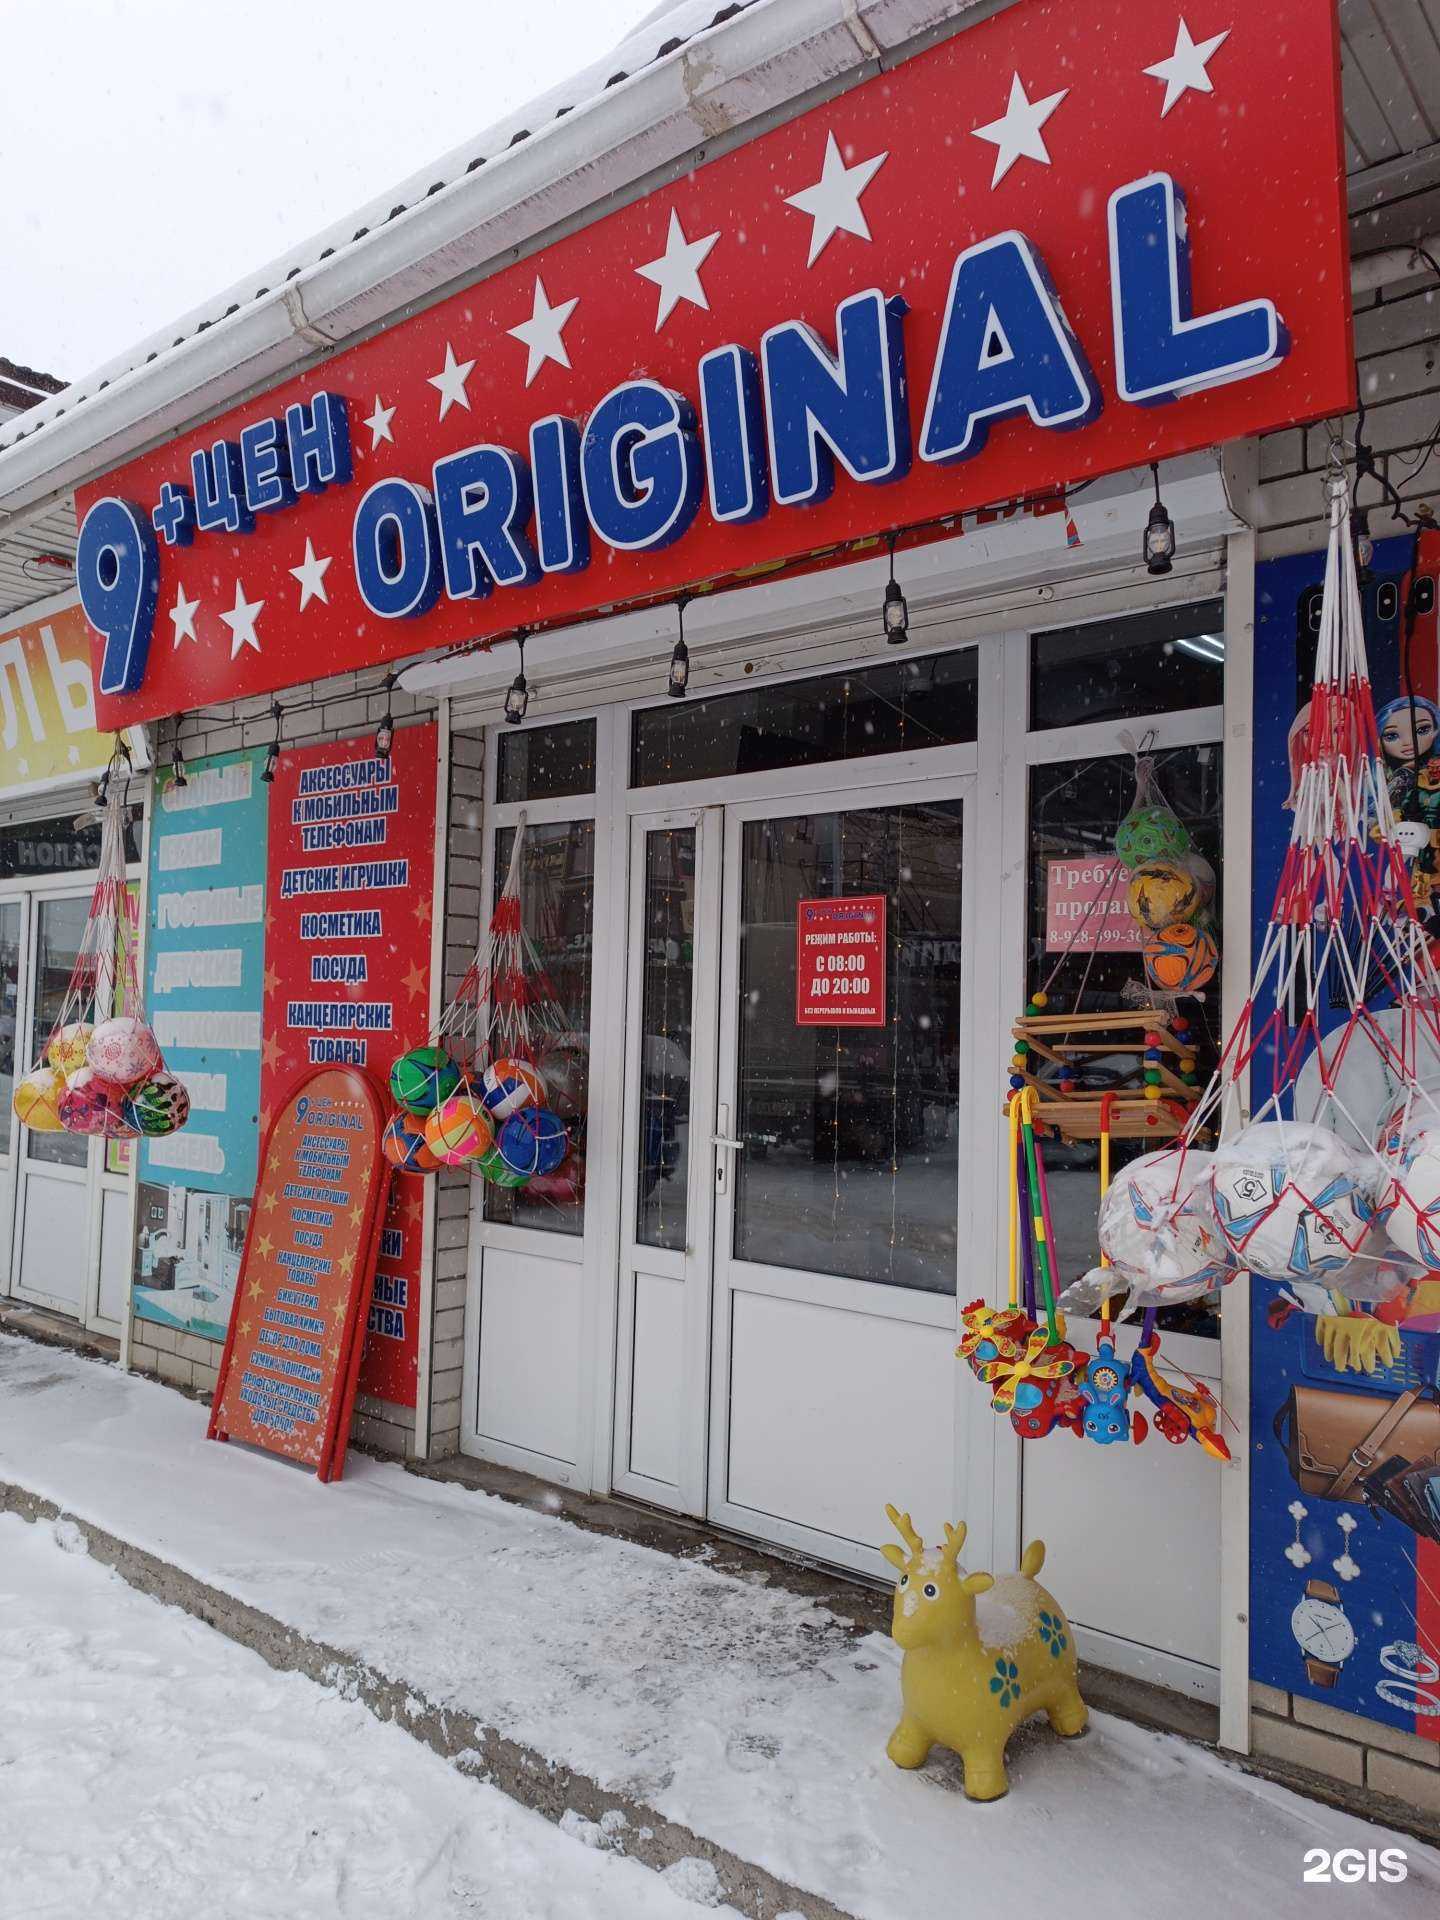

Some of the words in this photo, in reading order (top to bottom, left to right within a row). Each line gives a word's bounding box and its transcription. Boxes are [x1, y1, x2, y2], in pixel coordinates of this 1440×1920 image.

[353, 172, 1285, 620] ORIGINAL
[300, 759, 391, 795] АКСЕССУАРЫ
[304, 786, 398, 822] МОБИЛЬНЫМ
[302, 817, 386, 851] ТЕЛЕФОНАМ
[281, 867, 339, 898] ДЕТСКИЕ
[340, 860, 408, 890] ИГРУШКИ
[301, 909, 382, 939] КОСМЕТИКА
[805, 933, 836, 945] РЕЖИМ
[837, 931, 877, 944] РАБОТЫ:
[312, 955, 368, 983] ПОСУДА
[816, 955, 825, 972] С
[827, 954, 865, 972] 08:00
[811, 978, 830, 997] ДО
[832, 977, 870, 995] 20:00
[287, 1001, 392, 1031] КАНЦЕЛЯРСКИЕ
[309, 1038, 367, 1067] ТОВАРЫ
[307, 1111, 364, 1131] ORIGINAL
[301, 1135, 349, 1151] АКСЕССУАРЫ
[301, 1151, 350, 1168] МОБИЛЬНЫМ
[298, 1165, 343, 1182] ТЕЛЕФОНАМ
[284, 1183, 316, 1200] ДЕТСКИЕ
[316, 1188, 349, 1206] ИГРУШКИ
[291, 1207, 334, 1228] КОСМЕТИКА
[294, 1230, 324, 1248] ПОСУДА
[277, 1250, 333, 1275] КАНЦЕЛЯРСКИЕ
[287, 1267, 318, 1287] ТОВАРЫ
